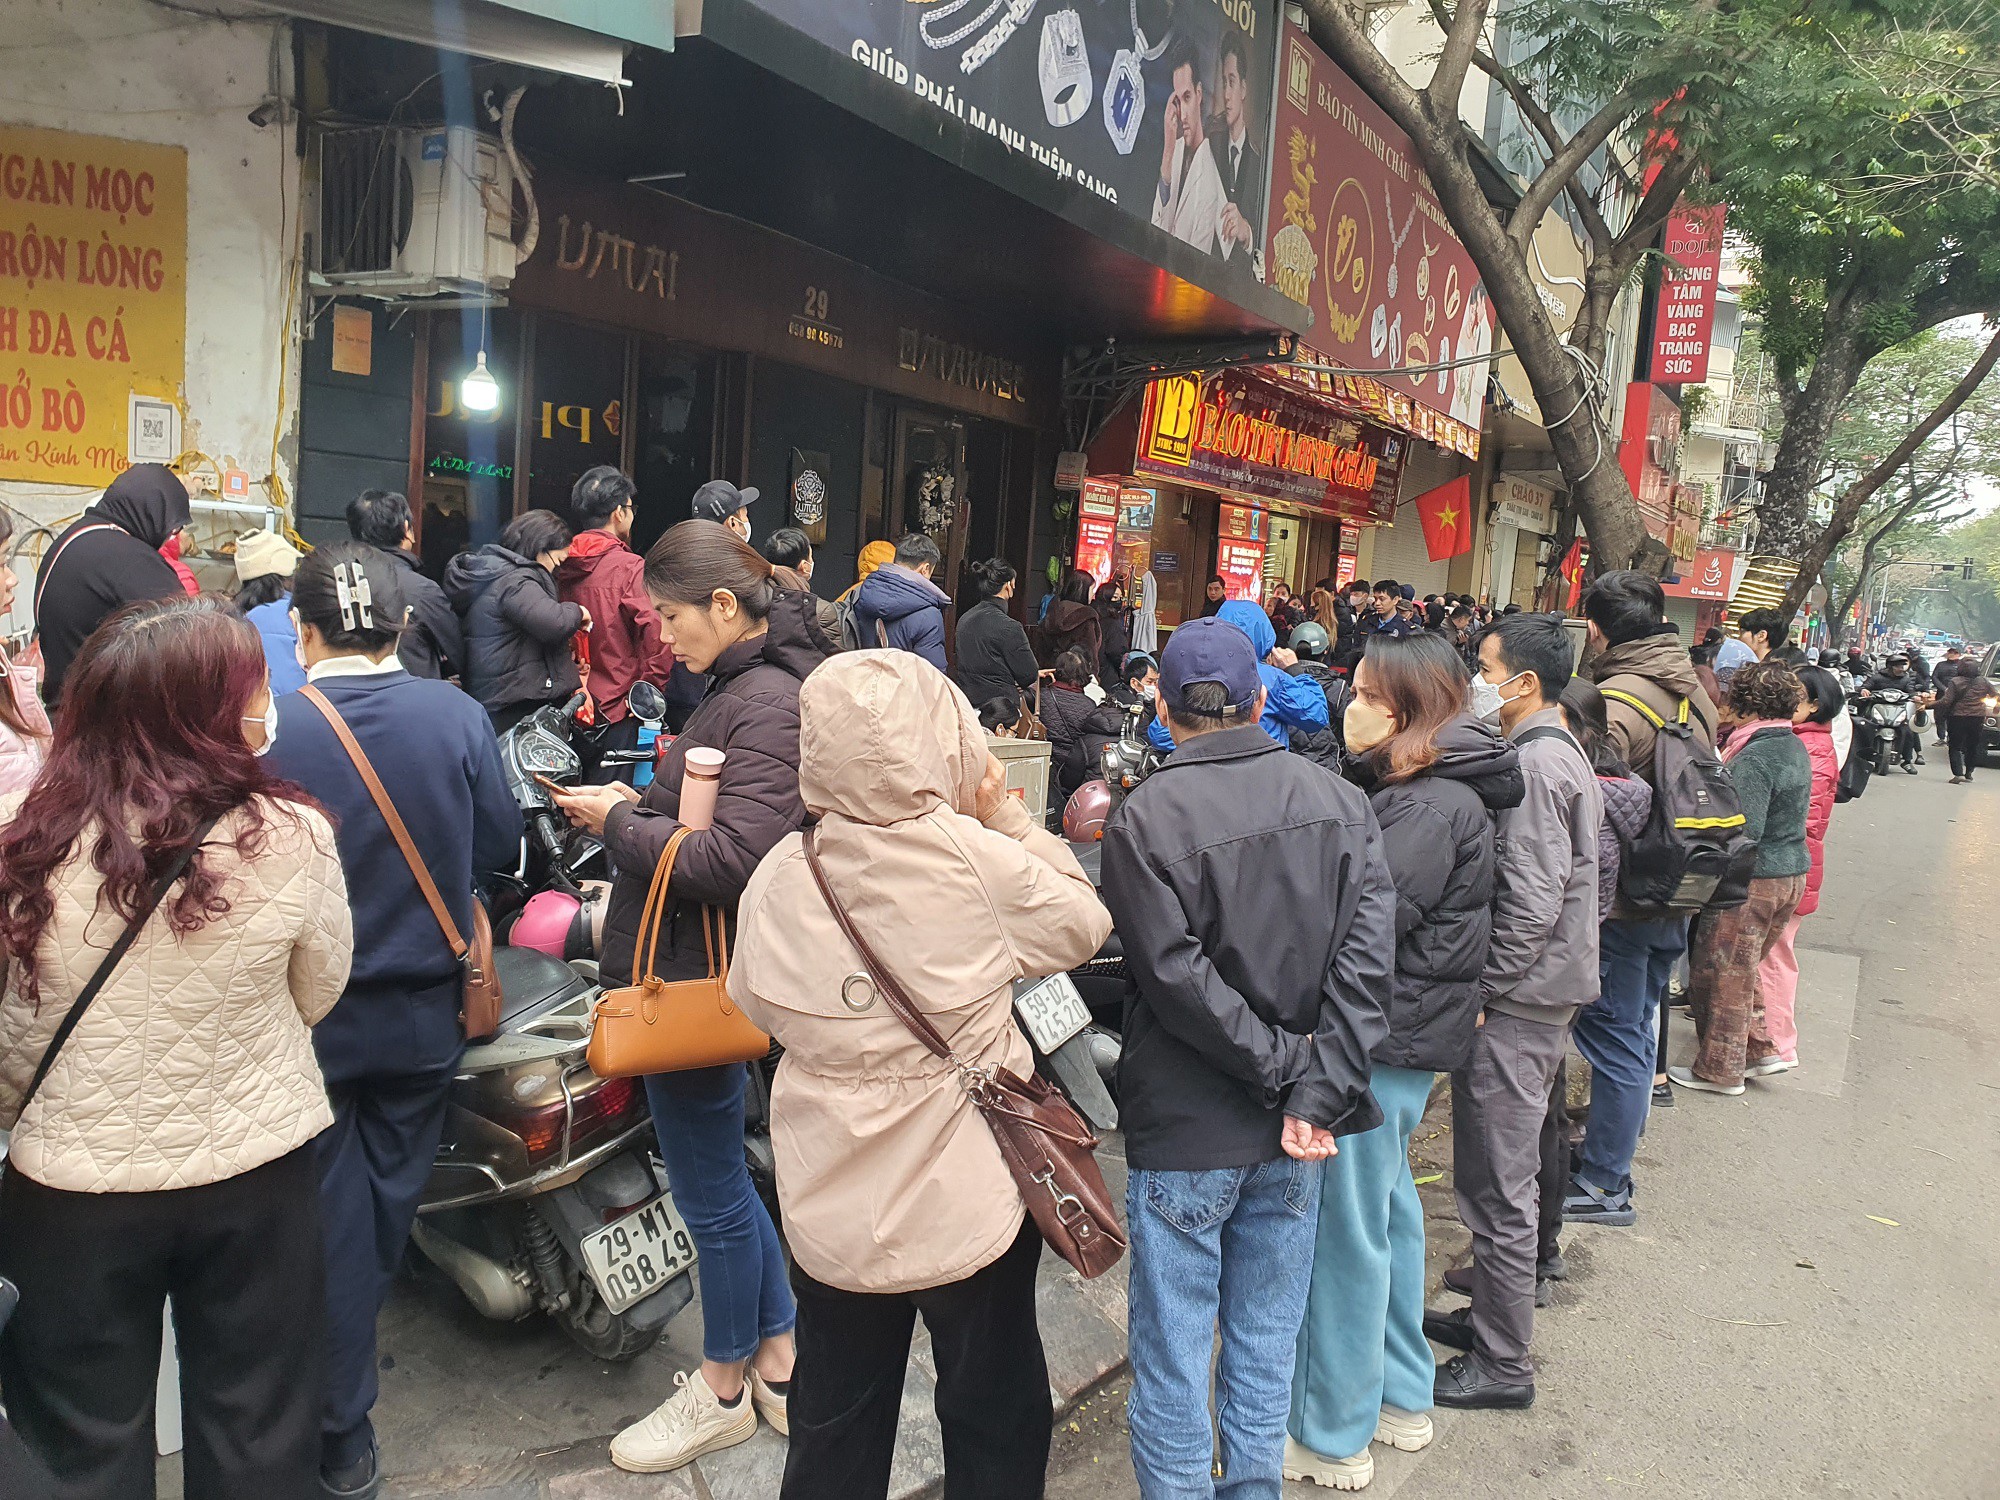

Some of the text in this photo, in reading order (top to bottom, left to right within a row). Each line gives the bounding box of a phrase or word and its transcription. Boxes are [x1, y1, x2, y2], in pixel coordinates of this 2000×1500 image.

[1317, 81, 1340, 120] BẢO
[1341, 104, 1360, 137] TÍN
[1359, 120, 1385, 162] MINH
[1385, 148, 1410, 183] CHÂU
[0, 153, 154, 225] GAN MỌC
[78, 230, 164, 292] LÒNG
[804, 286, 828, 320] 29
[1667, 302, 1704, 319] VÀNG
[1673, 283, 1702, 300] TÂM
[28, 309, 76, 357] ĐA
[86, 305, 130, 363] CÁ
[1659, 341, 1704, 356] TRANG
[1668, 322, 1697, 340] BẠC
[1664, 357, 1692, 374] SỨC
[42, 378, 85, 434] BÒ
[26, 440, 80, 468] Kính
[599, 1201, 672, 1268] 29-M1
[606, 1230, 693, 1304] 098.49
